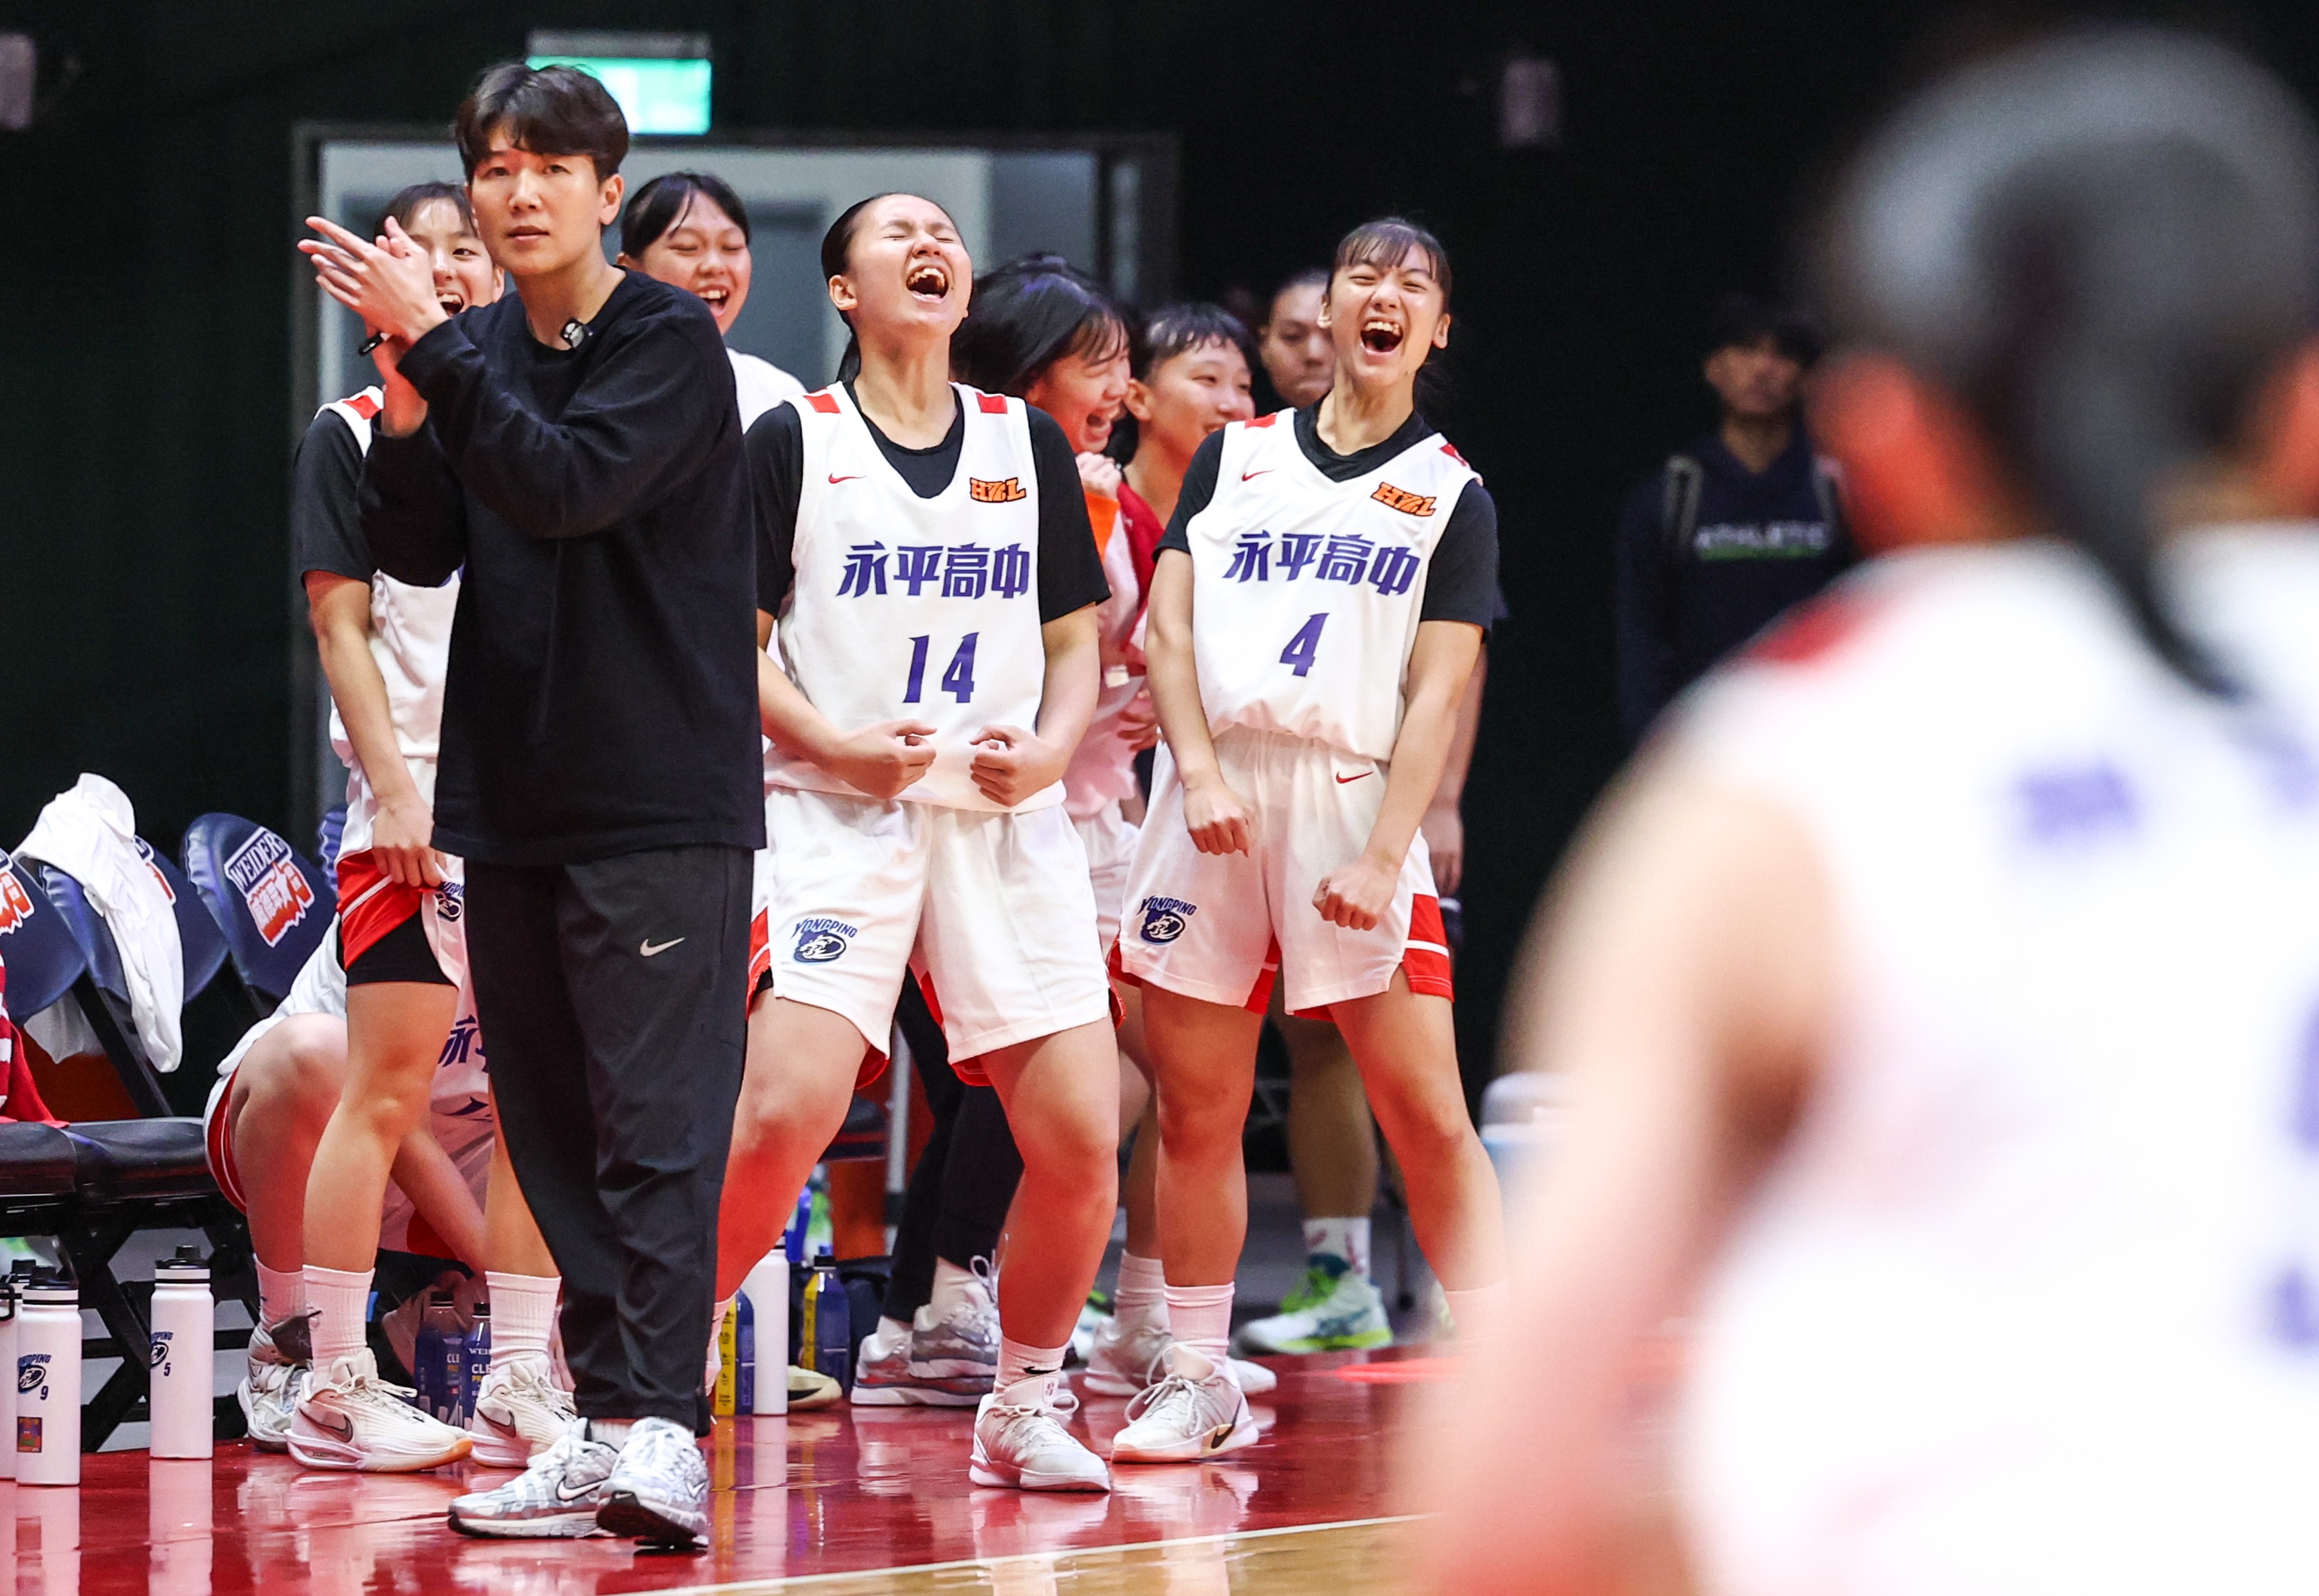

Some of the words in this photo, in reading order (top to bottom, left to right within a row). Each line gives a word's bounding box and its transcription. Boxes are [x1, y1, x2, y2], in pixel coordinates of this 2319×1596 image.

[835, 540, 1030, 600] 永平高中
[1222, 529, 1421, 596] 永平高中
[902, 631, 980, 703] 14
[1279, 612, 1330, 678] 4
[230, 833, 284, 890] WEIDER
[790, 917, 858, 938] YONGPING
[1135, 895, 1197, 916] YONGPING
[40, 1386, 48, 1400] 9
[164, 1362, 171, 1377] 5
